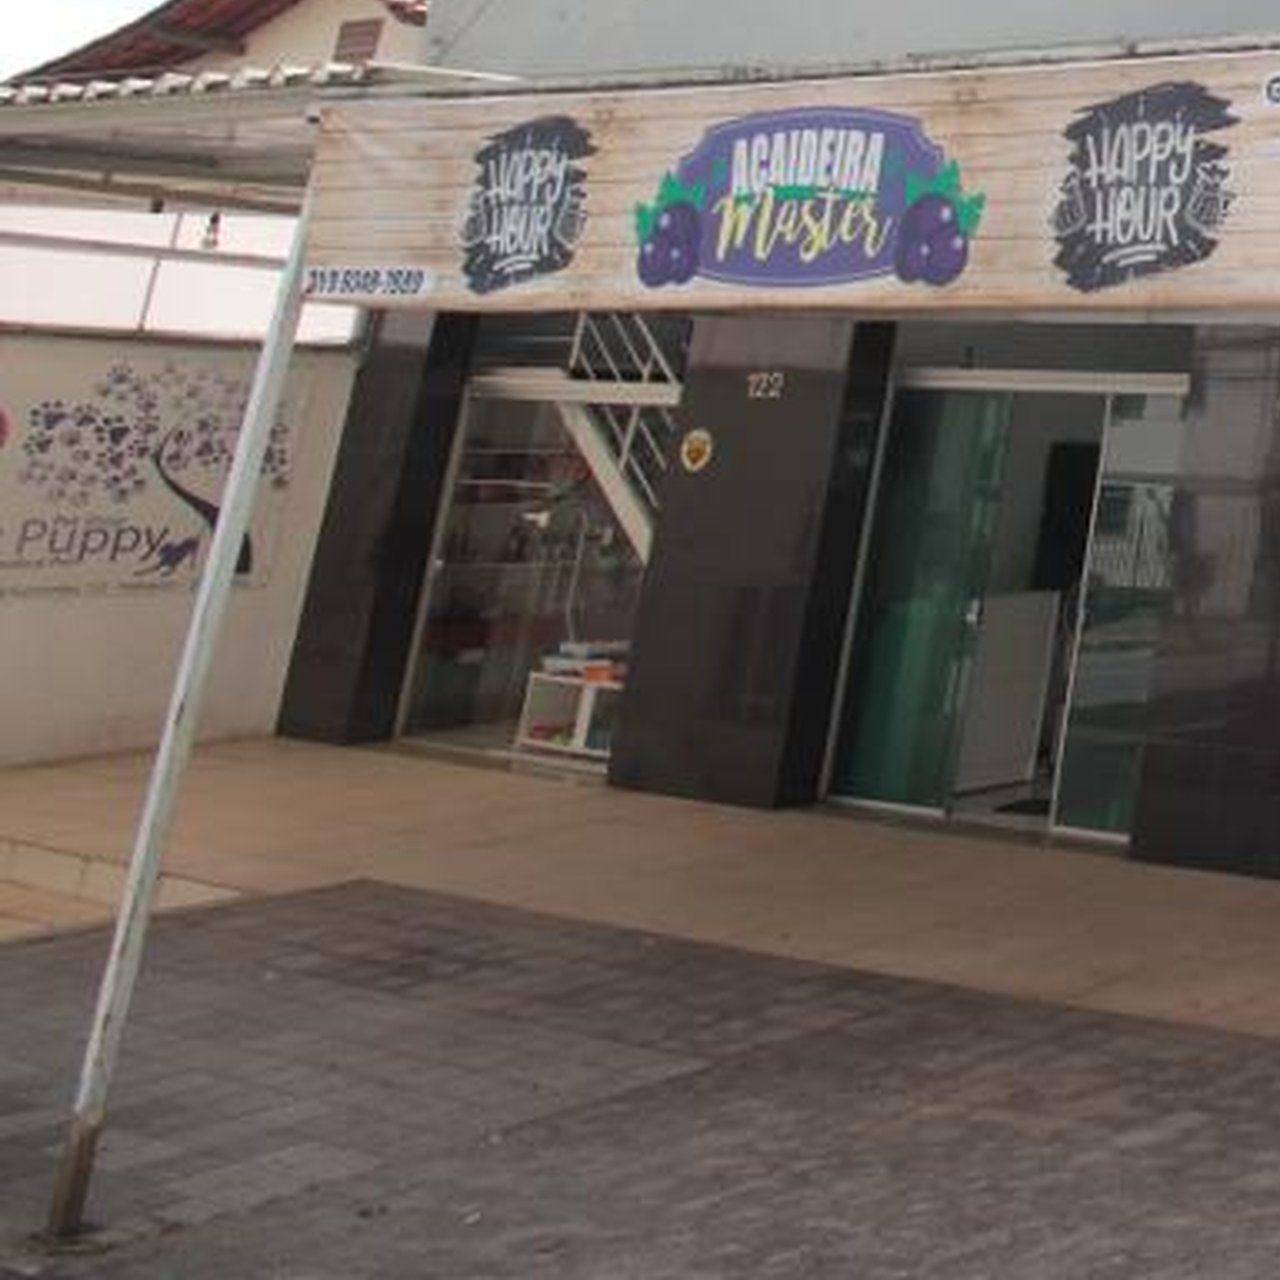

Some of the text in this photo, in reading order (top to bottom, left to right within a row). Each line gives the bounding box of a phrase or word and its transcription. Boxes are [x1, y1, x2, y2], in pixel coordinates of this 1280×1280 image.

[484, 147, 567, 204] HAPPY
[1083, 120, 1196, 188] HAPPY
[484, 204, 554, 255] HOUR
[711, 188, 892, 262] Master
[1086, 184, 1181, 246] HOUR
[746, 372, 784, 399] 122
[16, 518, 170, 562] Puppy
